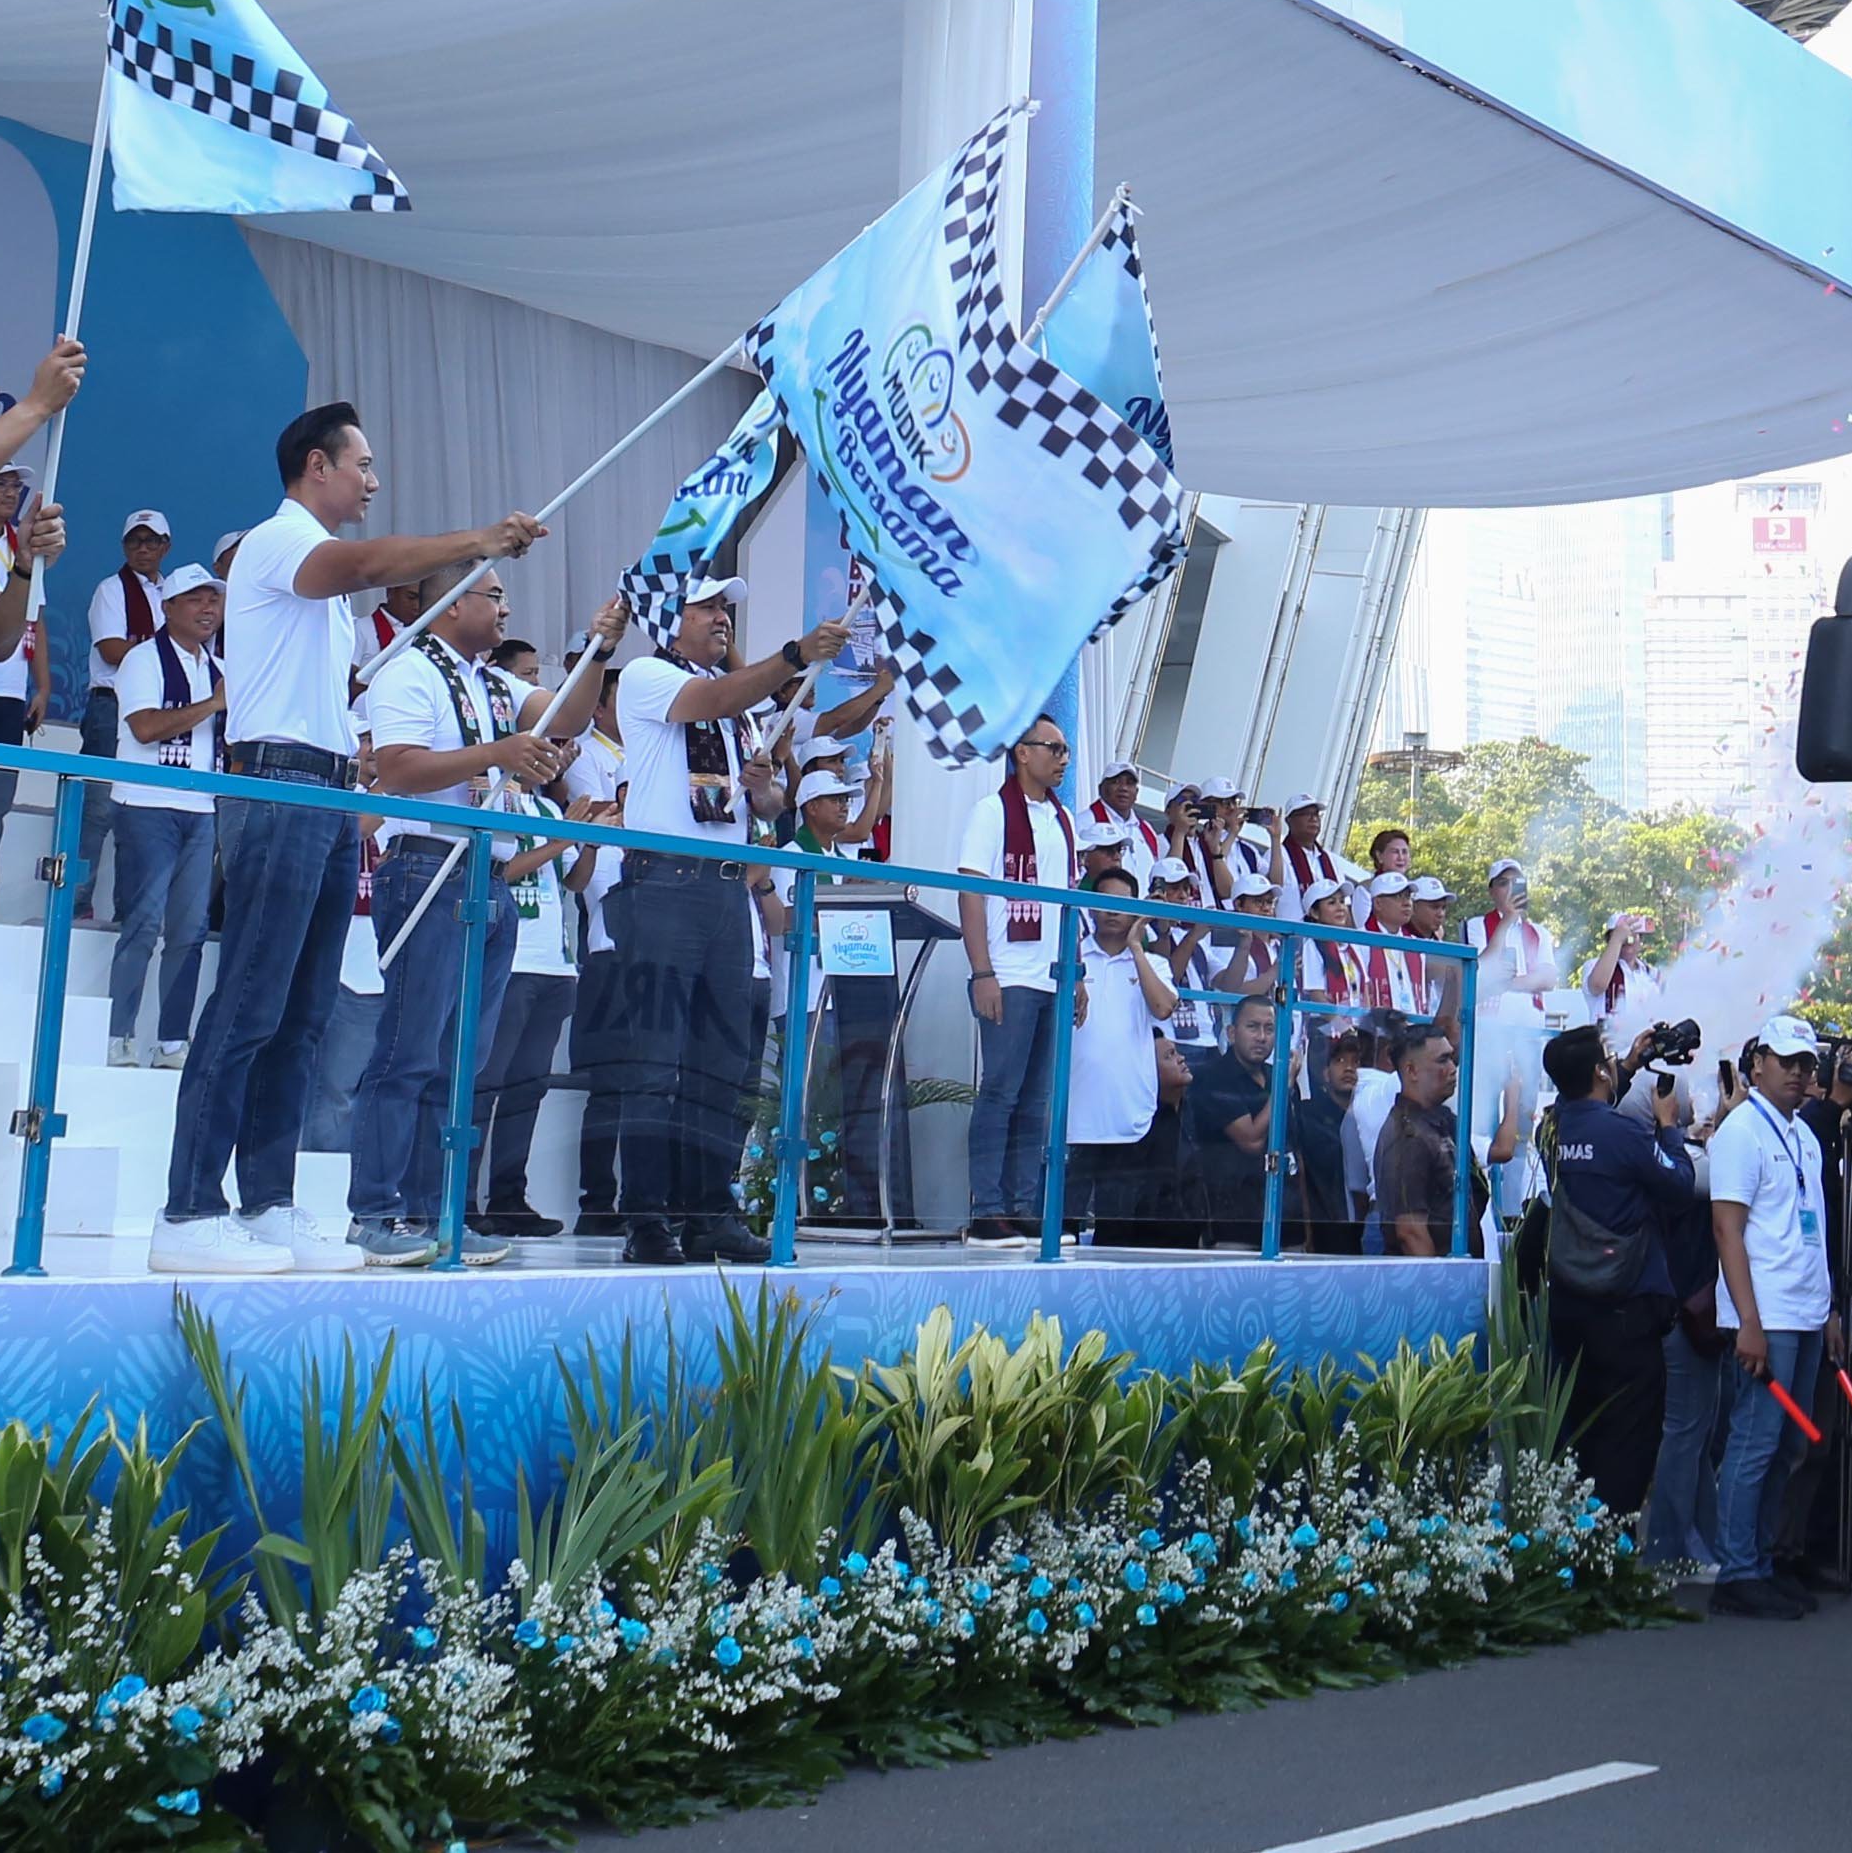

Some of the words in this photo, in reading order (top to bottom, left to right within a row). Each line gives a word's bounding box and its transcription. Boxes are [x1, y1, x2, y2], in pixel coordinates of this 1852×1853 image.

[826, 328, 971, 561] Nyaman
[882, 367, 934, 474] MUDIK
[835, 425, 964, 598] Bersama
[1555, 1144, 1594, 1162] MAS
